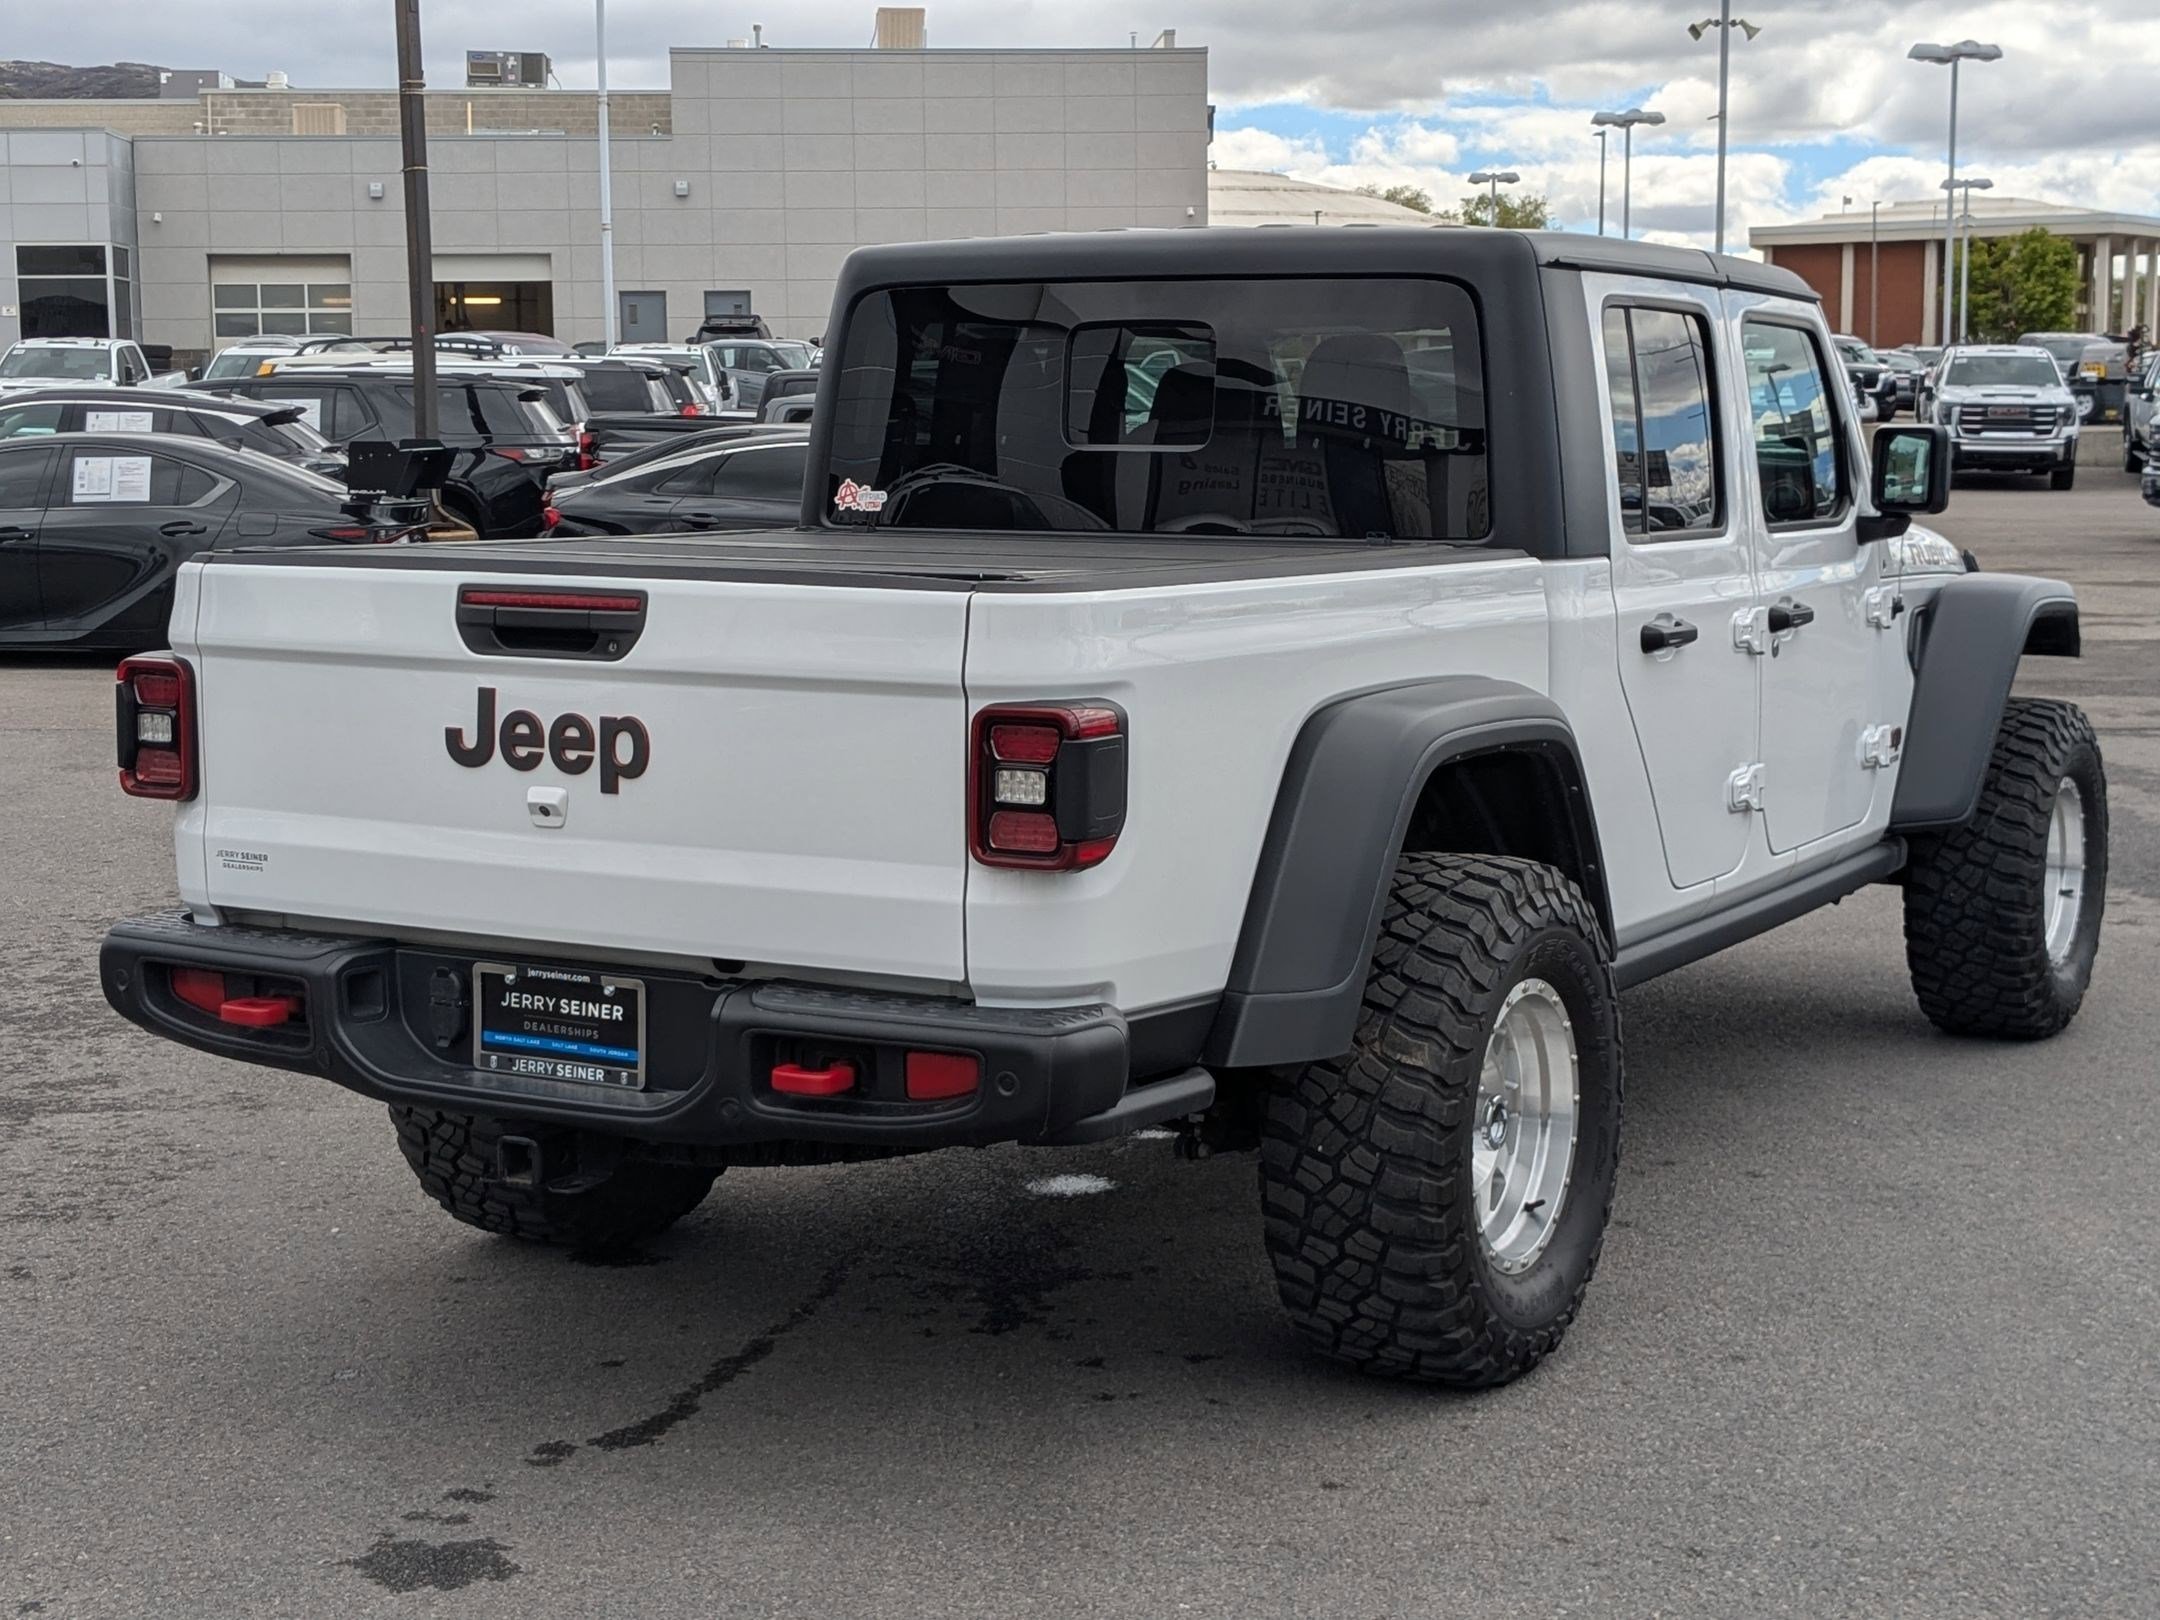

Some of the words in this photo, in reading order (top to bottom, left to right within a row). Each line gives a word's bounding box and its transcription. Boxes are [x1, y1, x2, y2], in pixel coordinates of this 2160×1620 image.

[445, 686, 650, 795] Jeep
[216, 849, 240, 859] JERRY
[240, 852, 269, 862] SEINER
[527, 967, 592, 983] jerryseiner.com
[500, 991, 557, 1012] JERRY
[559, 998, 624, 1021] SEINER
[523, 1020, 600, 1040] DEALERSHIPS
[512, 1058, 556, 1075] JERRY
[556, 1064, 605, 1082] SEINER
